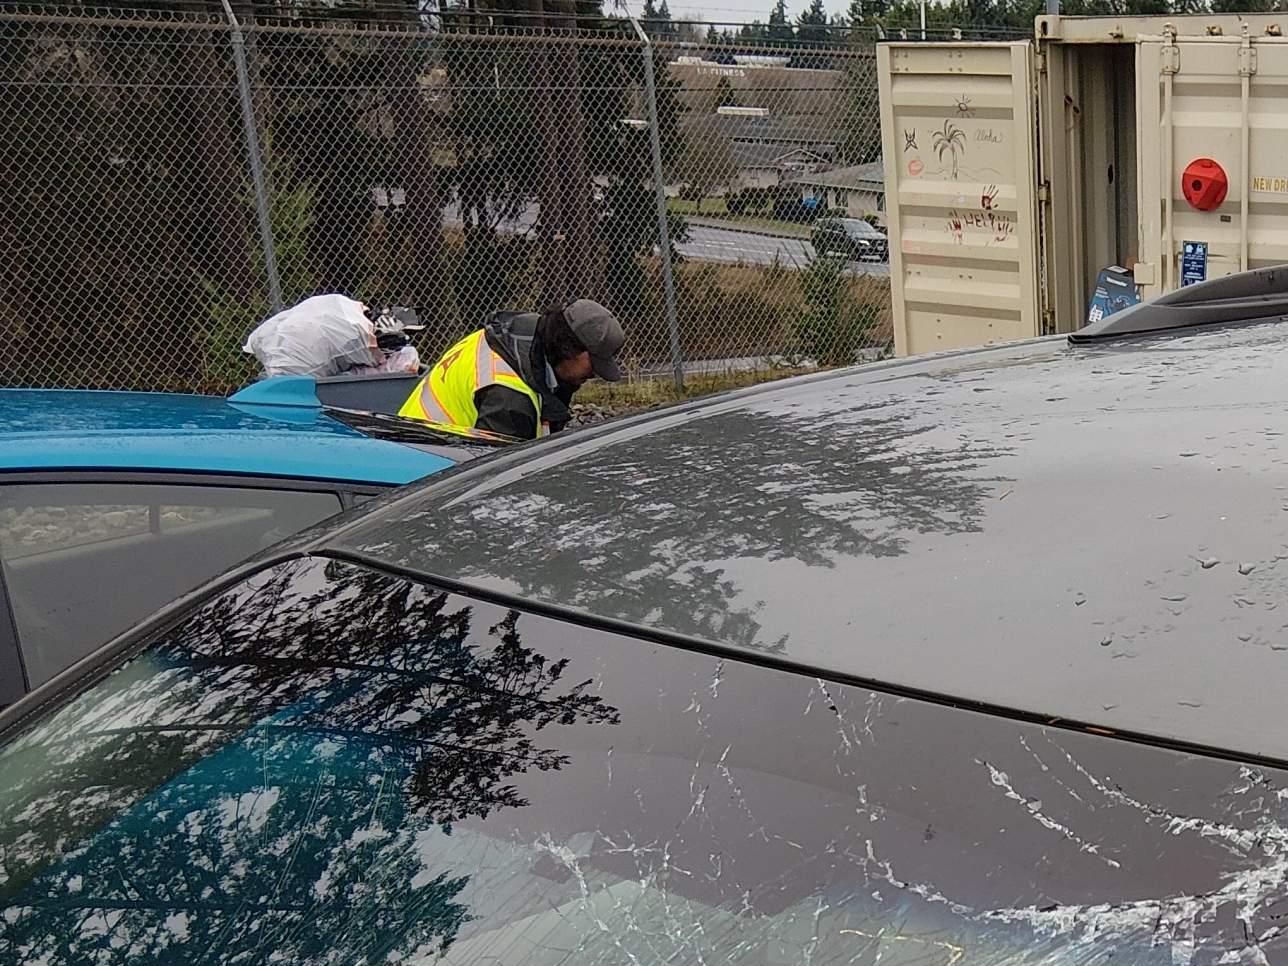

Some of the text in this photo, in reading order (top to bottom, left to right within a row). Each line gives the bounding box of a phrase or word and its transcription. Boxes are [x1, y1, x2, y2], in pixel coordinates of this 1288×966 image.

[697, 67, 745, 77] LA FITNESS
[1253, 177, 1272, 191] NEW
